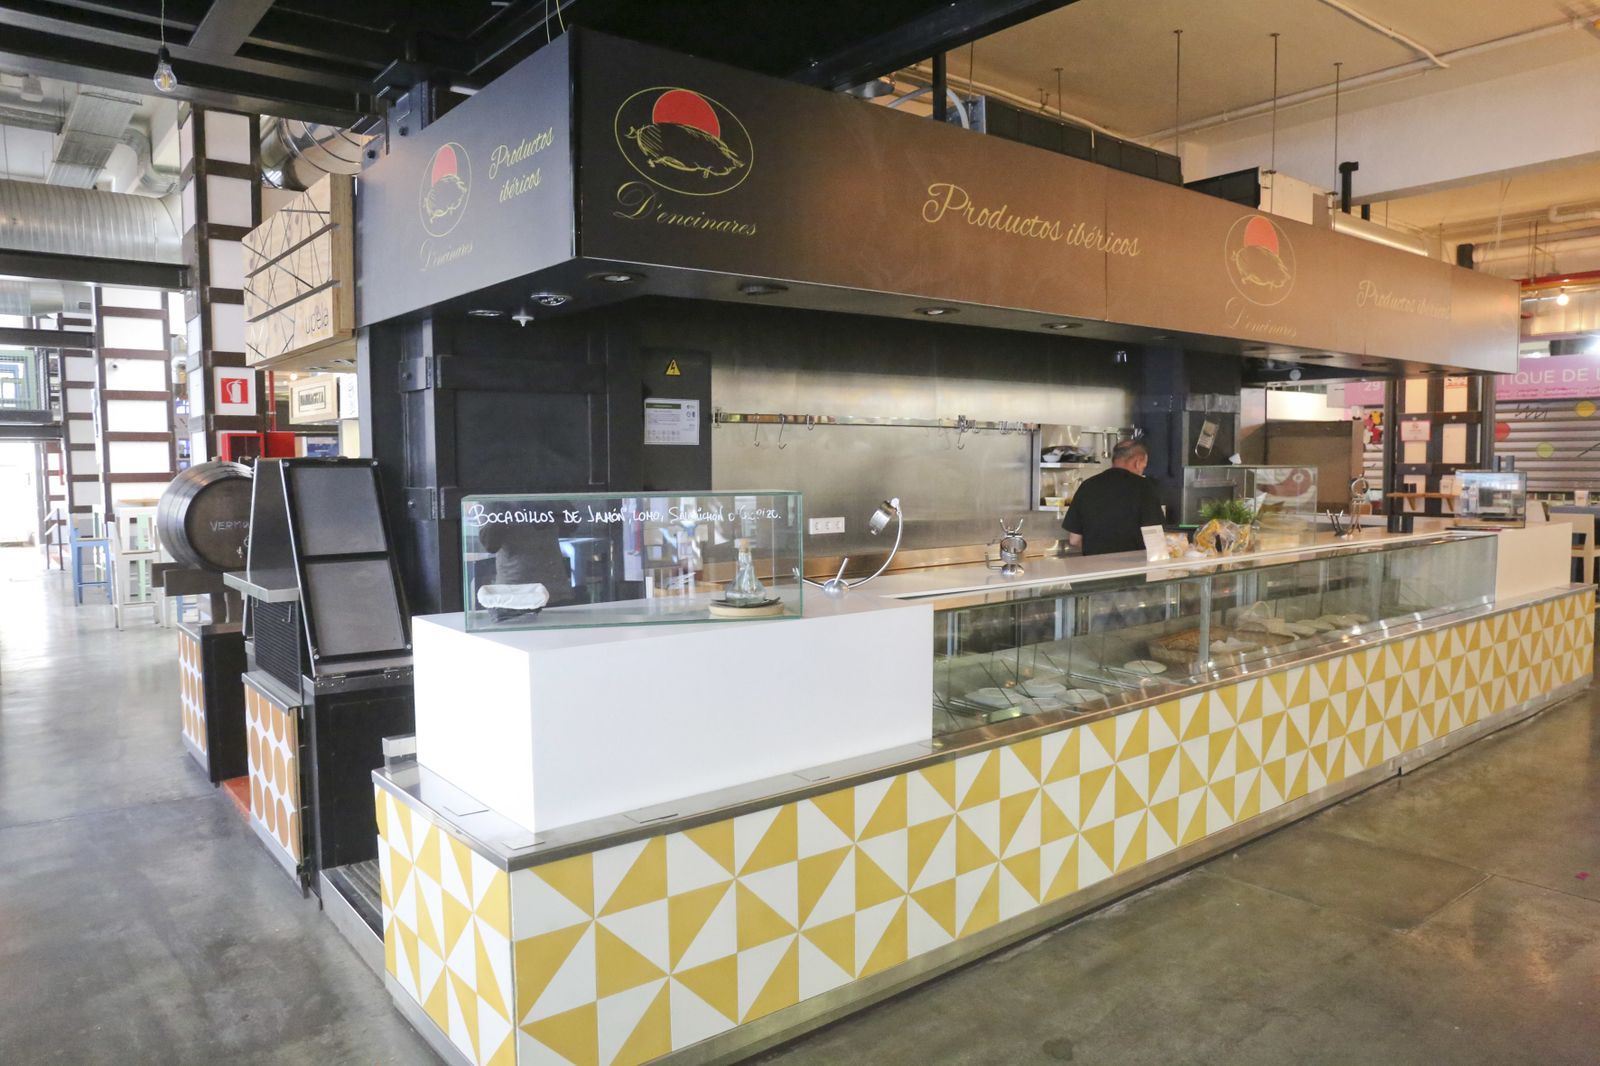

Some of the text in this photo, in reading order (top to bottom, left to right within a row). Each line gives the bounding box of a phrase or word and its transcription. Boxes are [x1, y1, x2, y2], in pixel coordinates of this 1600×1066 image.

[488, 127, 555, 180] Productos
[499, 168, 542, 203] ibéricos
[612, 180, 757, 237] D'encinares
[921, 183, 1141, 257] Productos ibéricos
[1364, 382, 1381, 392] 29
[1562, 367, 1589, 383] DE
[562, 509, 582, 524] DE
